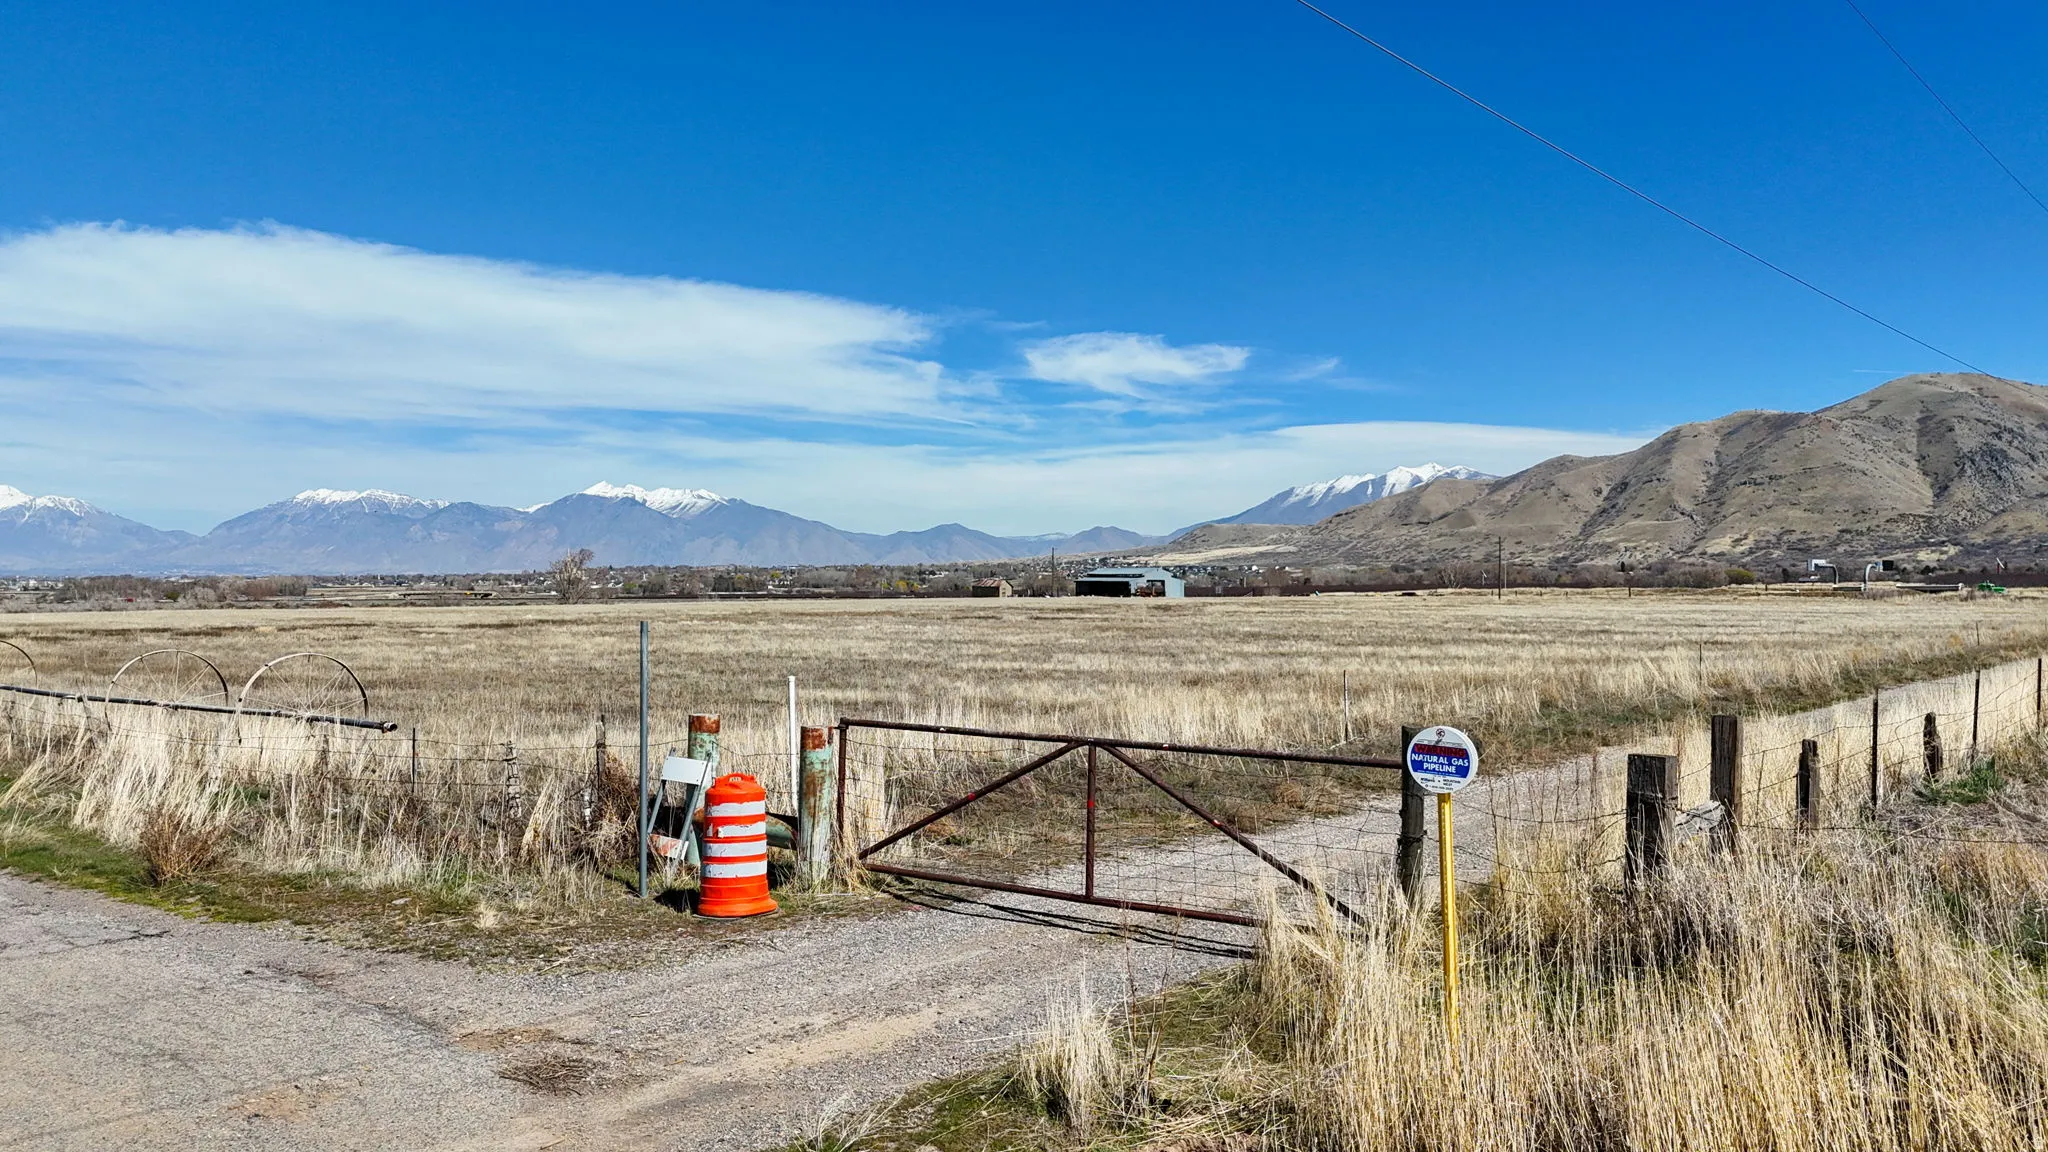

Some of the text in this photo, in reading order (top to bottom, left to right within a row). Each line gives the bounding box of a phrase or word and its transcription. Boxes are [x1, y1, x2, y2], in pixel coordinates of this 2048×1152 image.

[1414, 743, 1466, 757] WARNING
[1412, 753, 1469, 767] NATURAL GAS
[1423, 763, 1457, 773] PIPELINE
